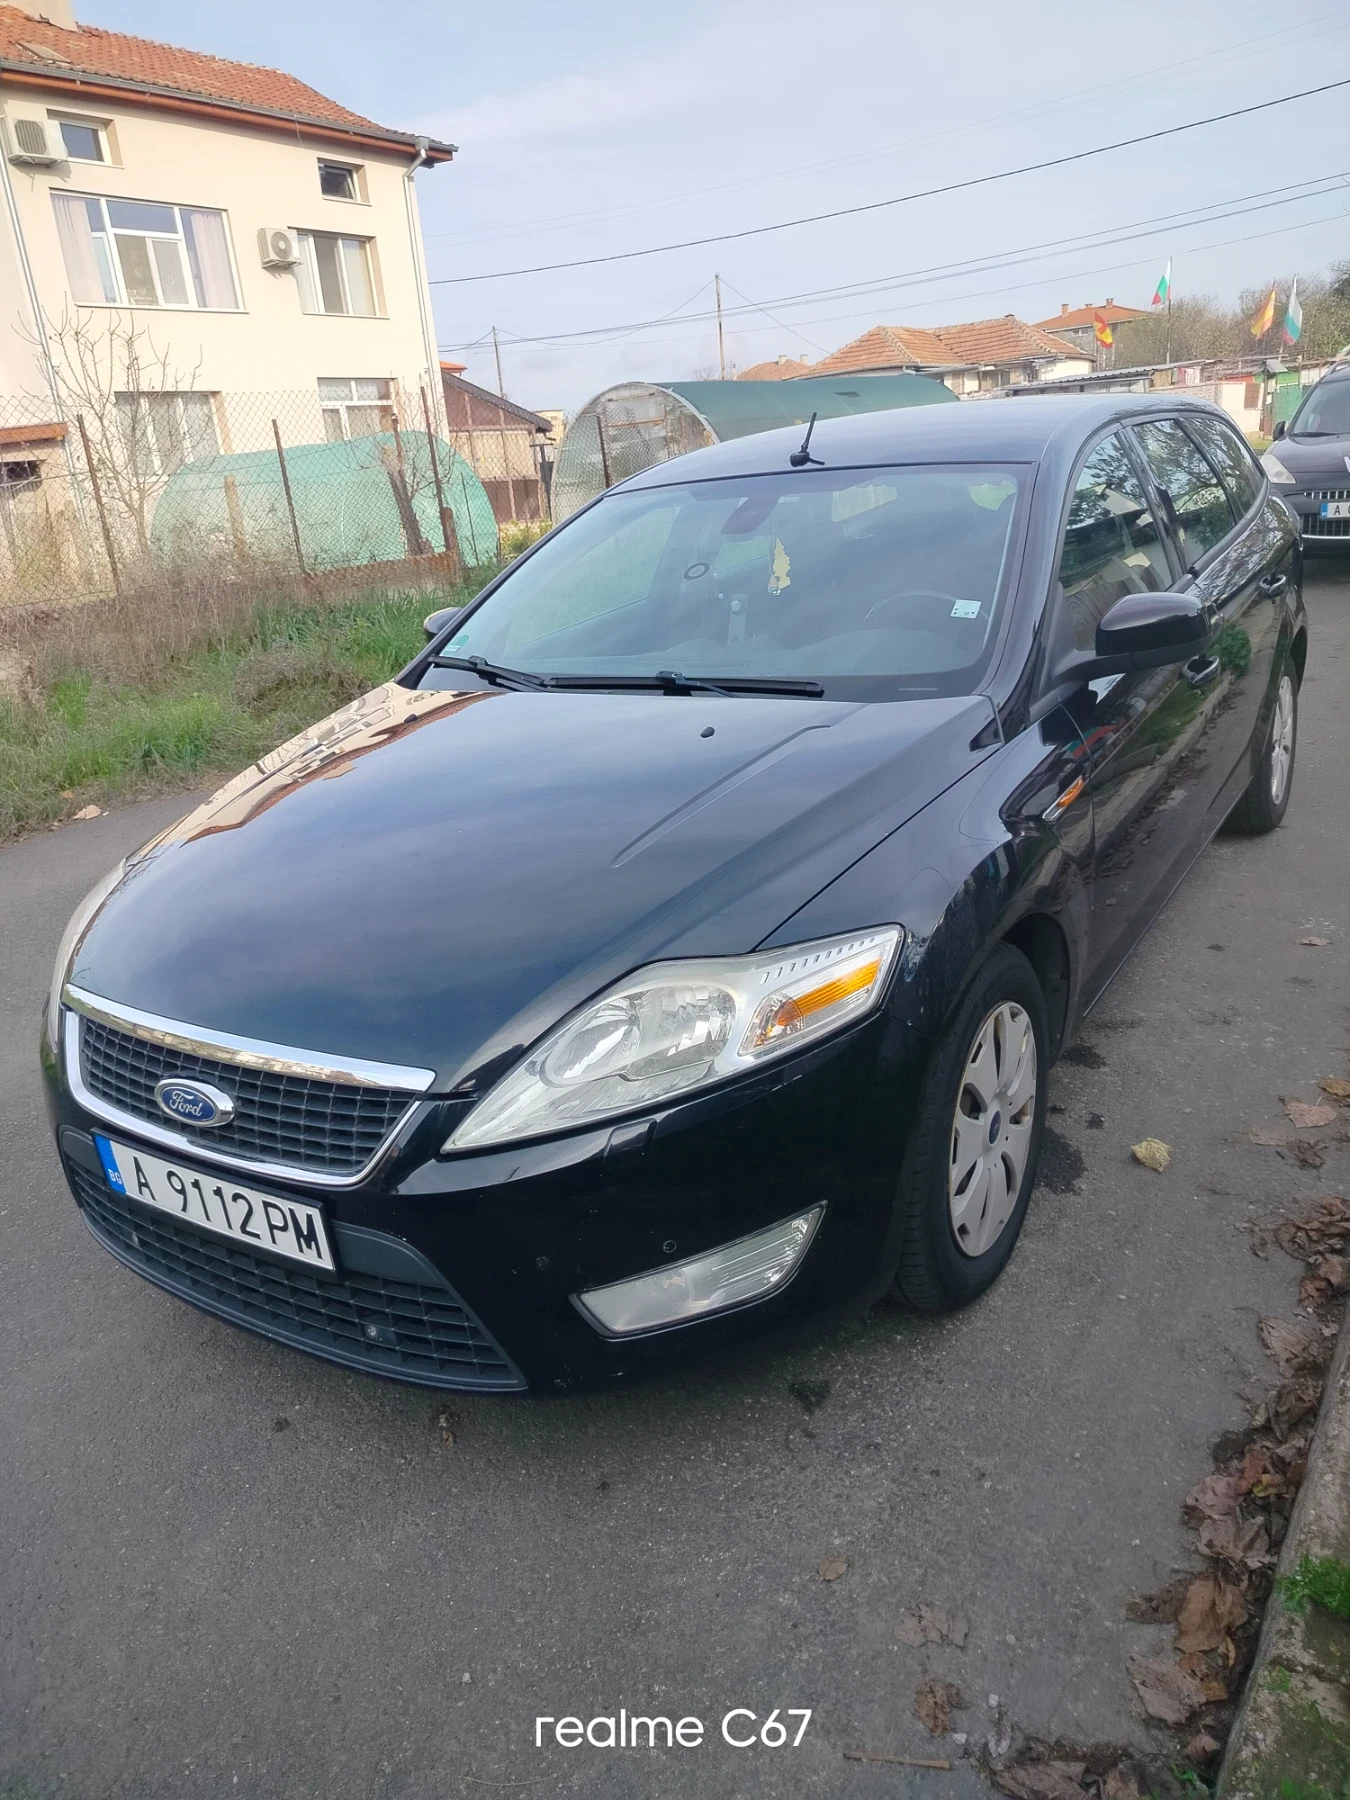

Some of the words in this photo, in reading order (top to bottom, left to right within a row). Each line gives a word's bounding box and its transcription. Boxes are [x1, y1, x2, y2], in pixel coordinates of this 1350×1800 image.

[169, 1090, 203, 1117] Ford
[108, 1168, 123, 1185] BG
[132, 1155, 157, 1202] A
[166, 1169, 324, 1260] 9112PM
